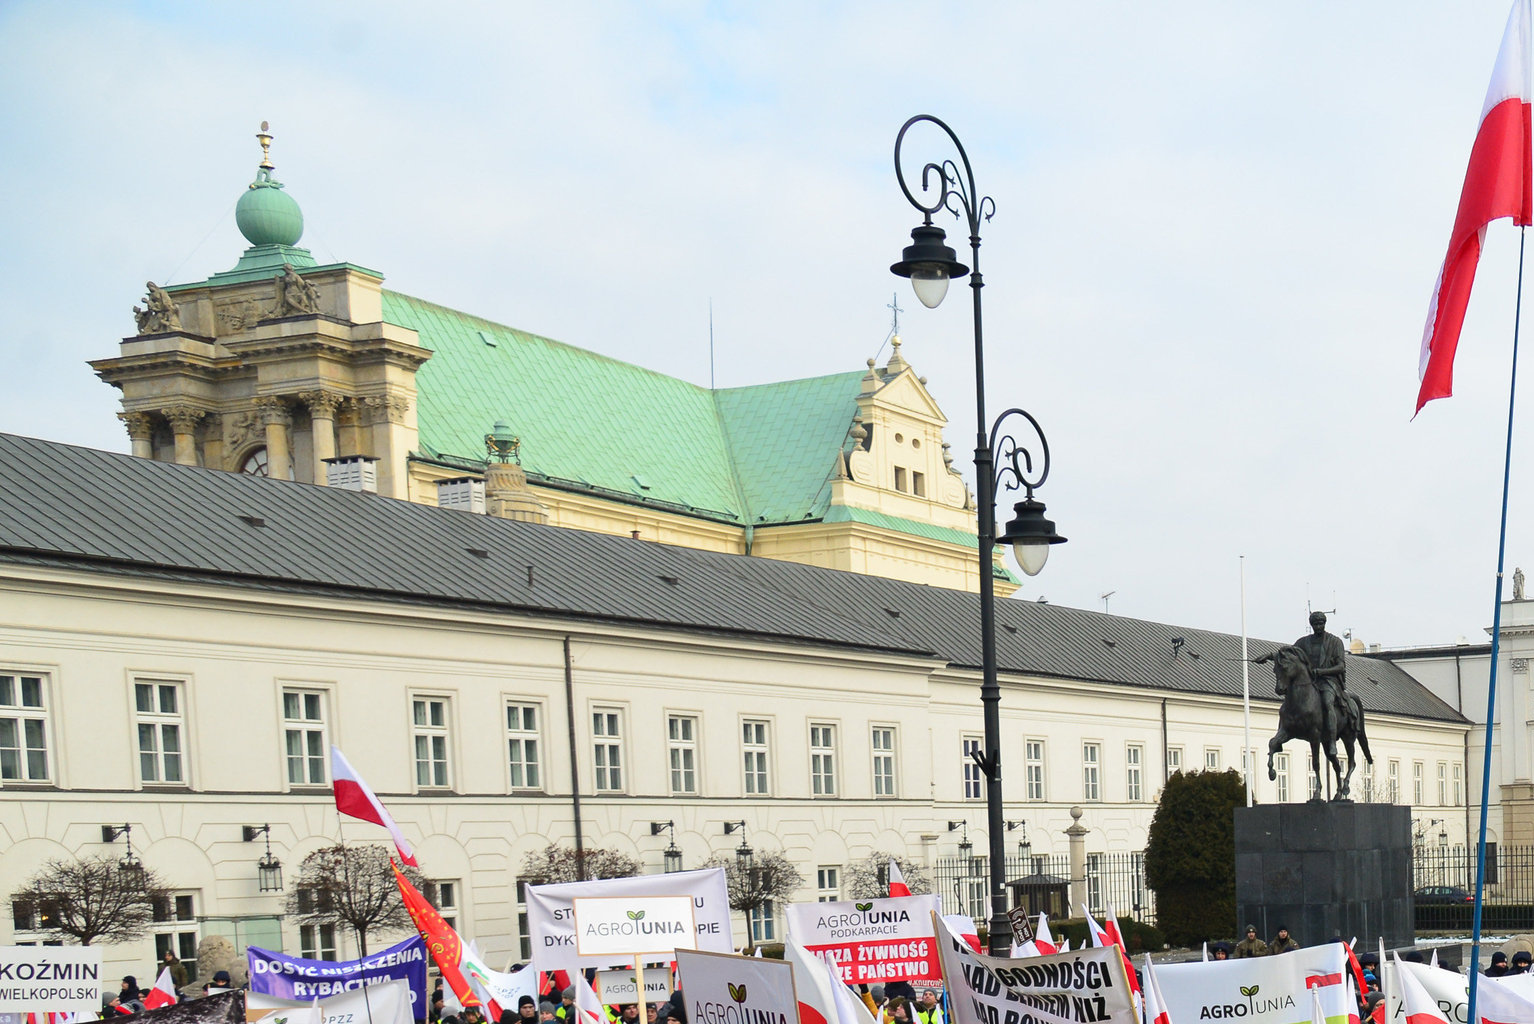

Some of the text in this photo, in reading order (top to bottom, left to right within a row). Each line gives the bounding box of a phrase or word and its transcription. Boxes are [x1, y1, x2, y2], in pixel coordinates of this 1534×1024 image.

[544, 922, 720, 947] DYK PIE
[830, 925, 898, 939] PODKARPACIE
[858, 940, 929, 961] ŻYWNOŚĆ
[0, 959, 98, 981] KOŹMIN
[254, 947, 423, 977] DOSYĆ NISZCZENIA
[858, 958, 929, 979] PAŃSTWO
[995, 956, 1113, 990] GODNOŚCI
[0, 988, 98, 1001] WIELKOPOLSKI
[1071, 992, 1112, 1023] NIŻ
